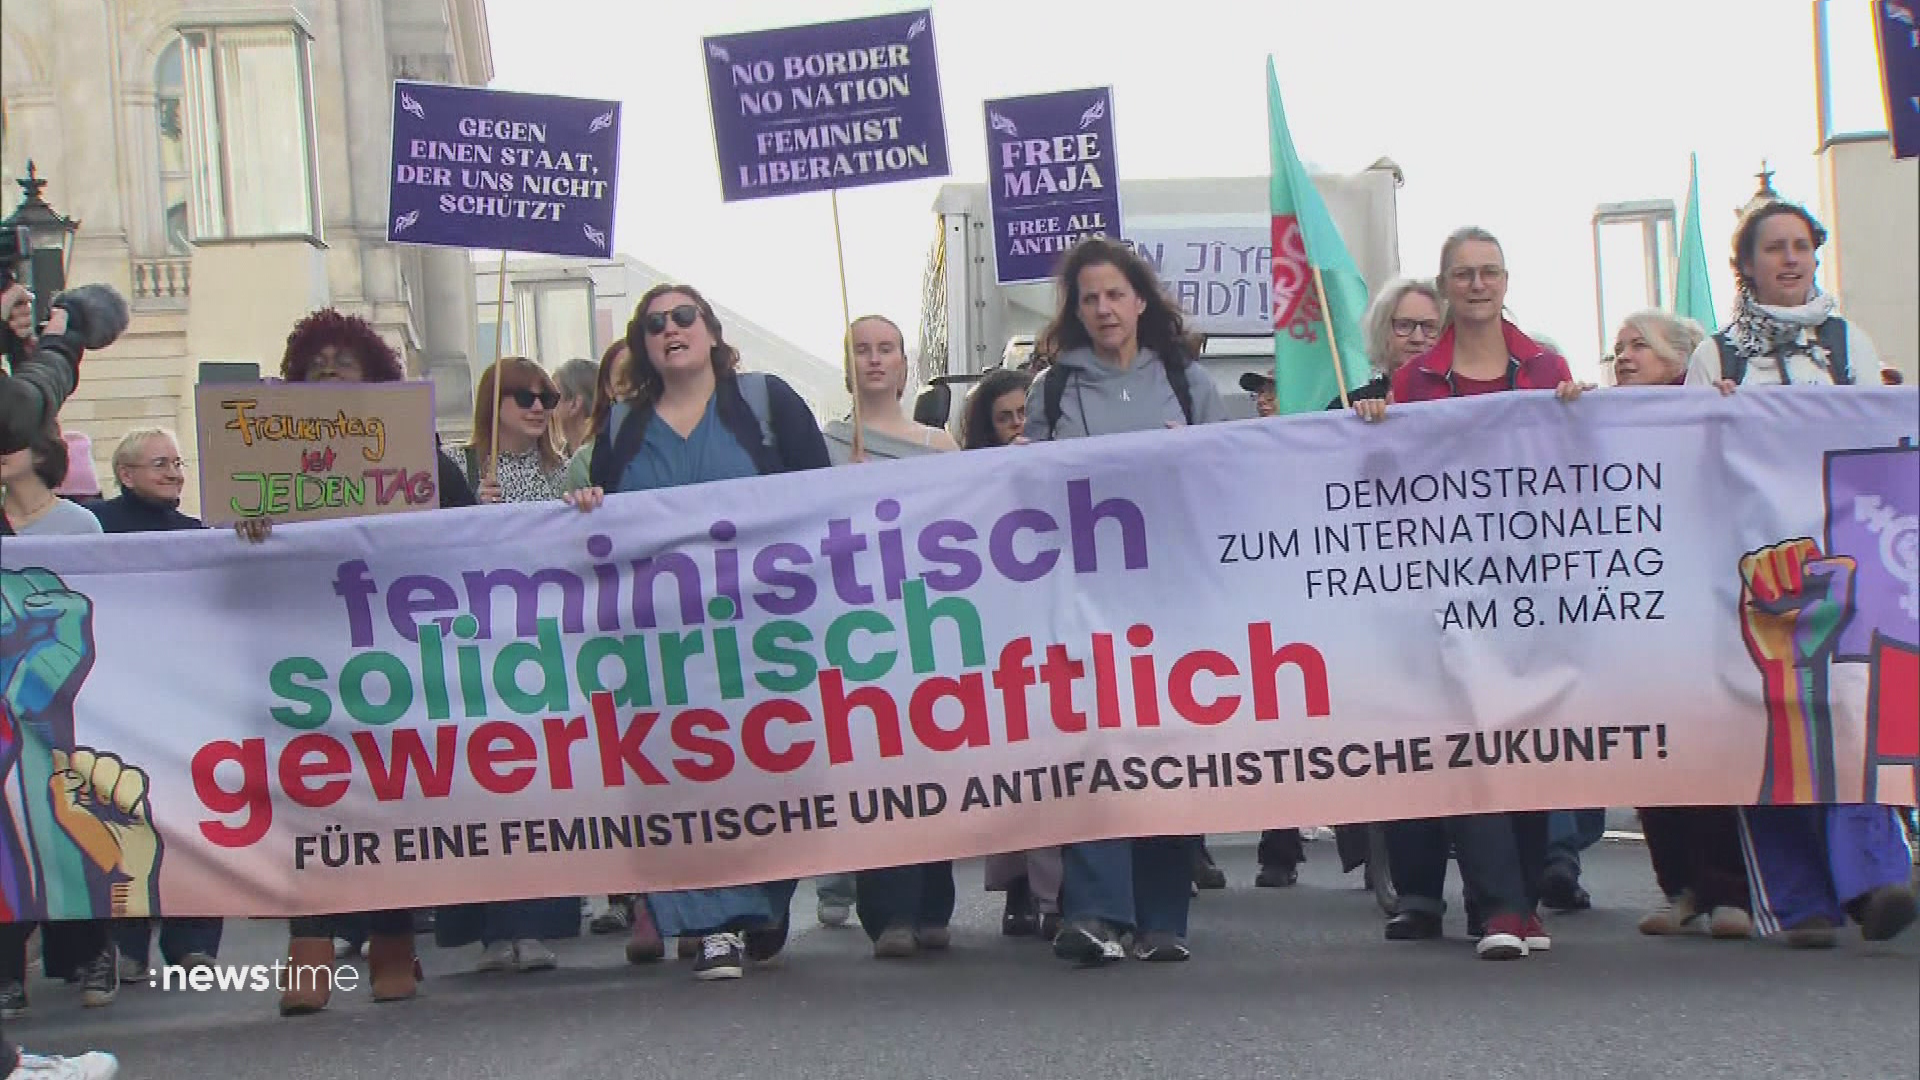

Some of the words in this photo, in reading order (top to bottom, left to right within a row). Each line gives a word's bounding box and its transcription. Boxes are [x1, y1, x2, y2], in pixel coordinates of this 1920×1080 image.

[732, 60, 775, 86] NO
[783, 44, 910, 81] BORDER
[740, 90, 782, 116] NO
[791, 73, 910, 110] NATION
[458, 117, 547, 143] GEGEN
[757, 116, 902, 156] FEMINIST
[1002, 132, 1101, 169] FREE
[410, 139, 492, 164] EINEN
[500, 148, 599, 175] STAAT,
[739, 143, 929, 188] LIBERATION
[397, 164, 451, 186] DER
[462, 169, 514, 192] UNS
[522, 174, 608, 200] NICHT
[1004, 163, 1103, 198] MAJA
[439, 194, 566, 222] SCHÜTZT
[1008, 216, 1061, 238] FREE
[1066, 212, 1107, 232] ALL
[221, 400, 386, 463] Frauentag
[231, 472, 366, 517] JEDEN
[363, 467, 436, 506] TAG
[1325, 461, 1663, 512] DEMONSTRATION
[1218, 528, 1300, 564] ZUM
[1314, 504, 1663, 555] INTERNATIONALEN
[332, 477, 1149, 648] feministisch
[1305, 547, 1665, 599] FRAUENKAMPFTAG
[1441, 600, 1498, 630] AM
[1512, 596, 1546, 628] 8.
[1557, 587, 1666, 624] MÄRZ
[270, 578, 986, 729] solidarisch
[191, 620, 1331, 848] gewerkschaftlich
[295, 824, 381, 870] FÜR
[394, 823, 489, 863] EINE
[500, 793, 838, 856] FEMINISTISCHE
[849, 782, 947, 824] UND
[959, 736, 1434, 812] ANTIFASCHISTISCHE
[1444, 723, 1669, 769] ZUKUNFT!
